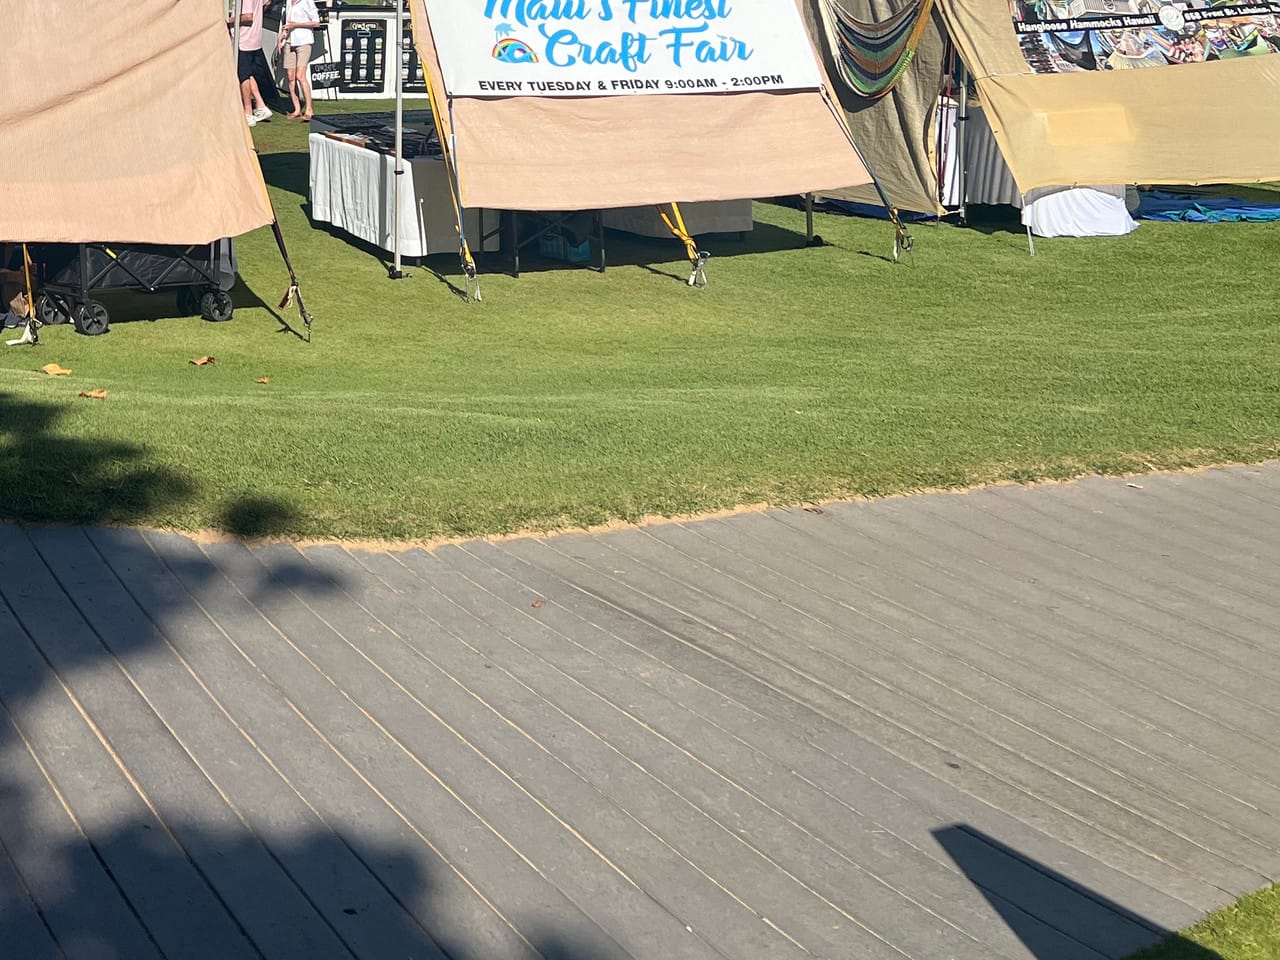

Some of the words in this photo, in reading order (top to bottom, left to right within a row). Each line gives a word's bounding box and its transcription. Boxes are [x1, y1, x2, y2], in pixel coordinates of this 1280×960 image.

[1017, 21, 1067, 33] Hangloose
[1070, 17, 1122, 29] Hammocks
[1124, 14, 1156, 26] Hawaii
[538, 23, 657, 73] Craft
[658, 21, 754, 68] Fair
[479, 80, 523, 91] EVERY
[527, 80, 591, 91] TUESDAY
[597, 80, 607, 90] &
[611, 79, 660, 90] FRIDAY
[664, 78, 718, 89] 9:00AM
[730, 74, 784, 87] 2:00PM
